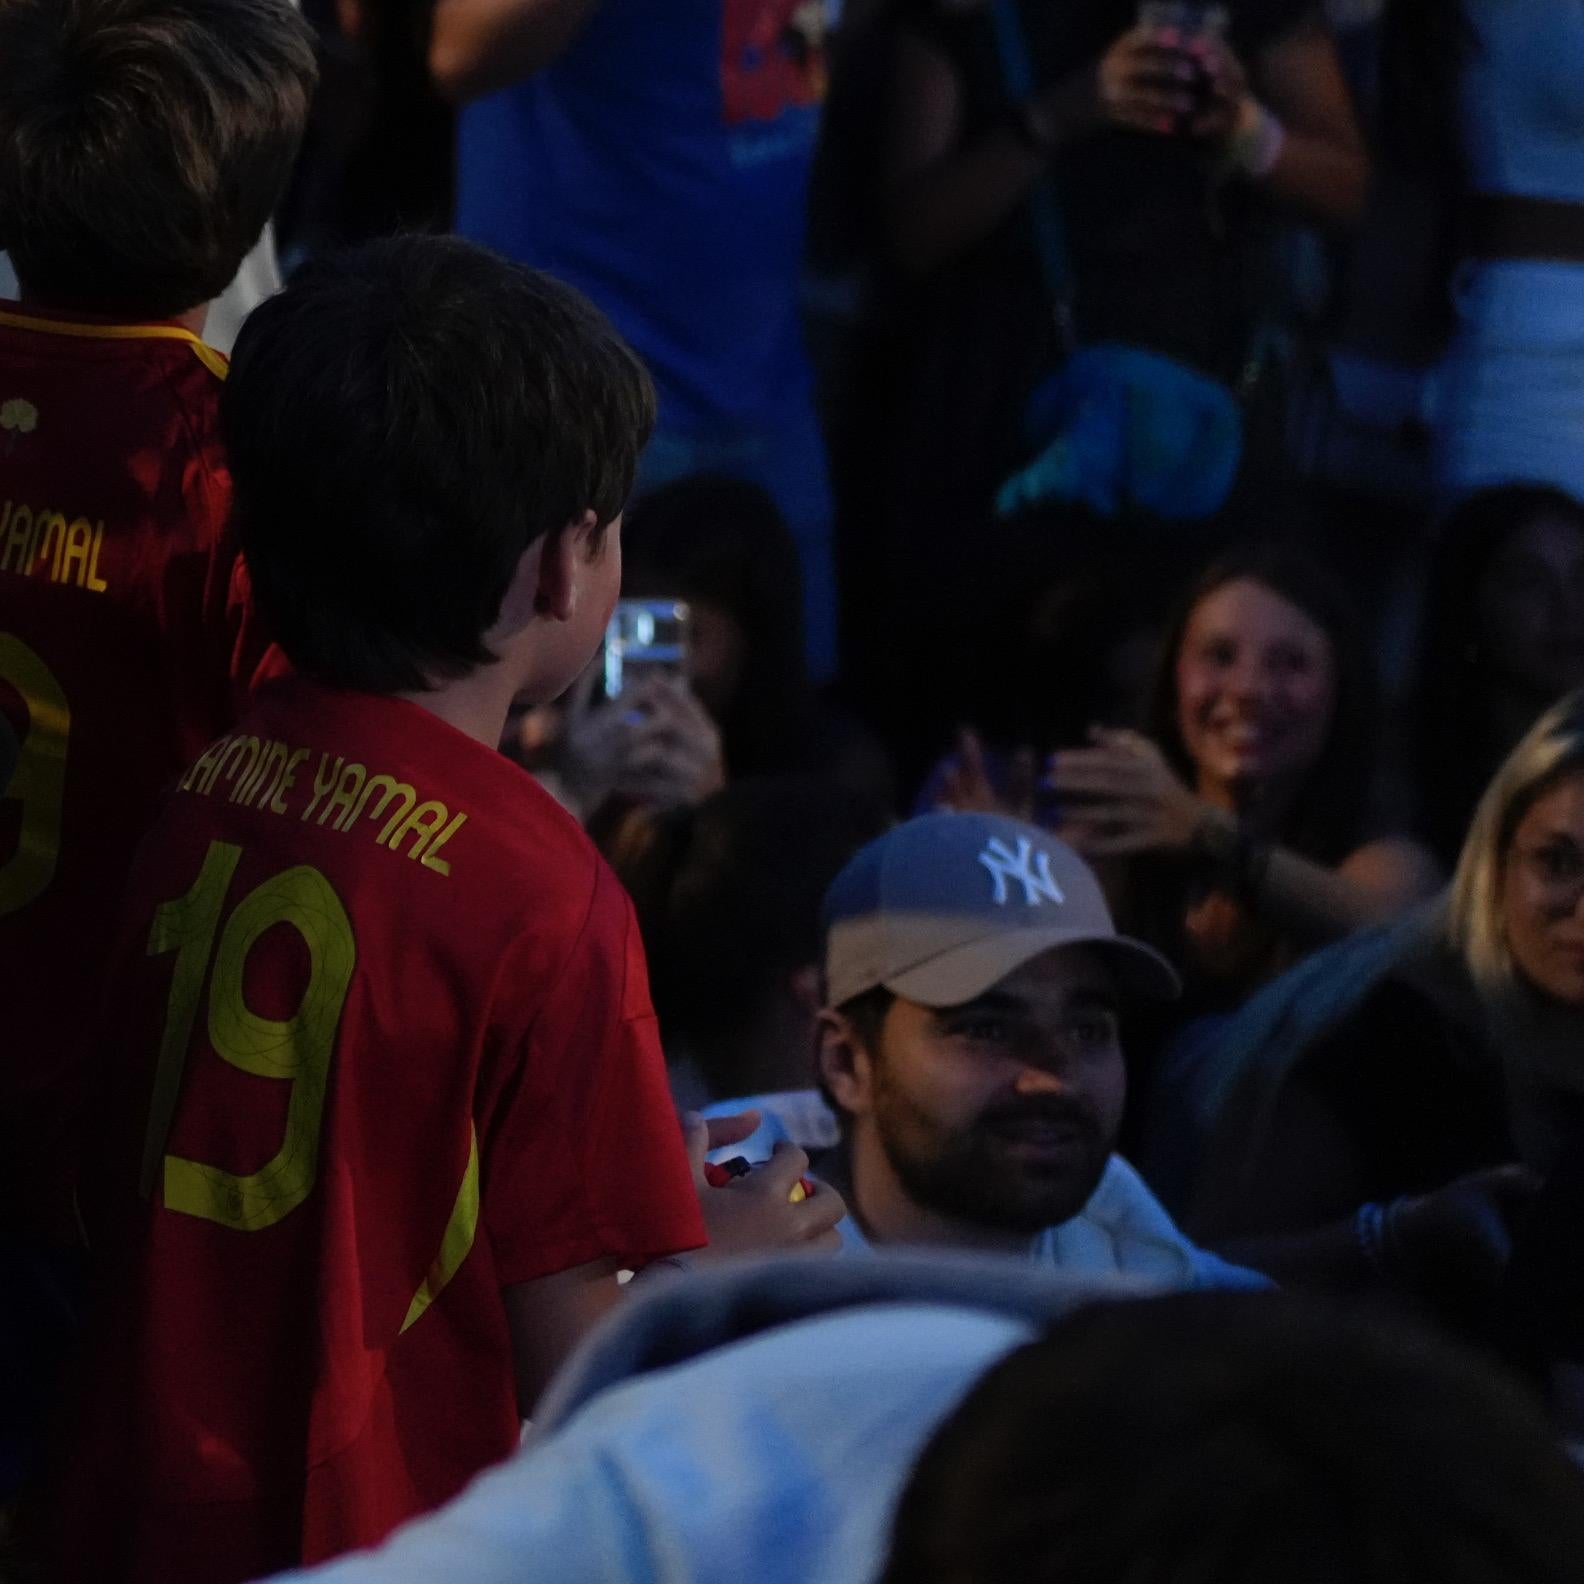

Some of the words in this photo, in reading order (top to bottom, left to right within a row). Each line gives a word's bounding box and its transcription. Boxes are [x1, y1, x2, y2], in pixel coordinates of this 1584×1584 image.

[301, 751, 469, 878] YAMAL
[977, 835, 1065, 906] NY
[137, 838, 357, 1233] 19
